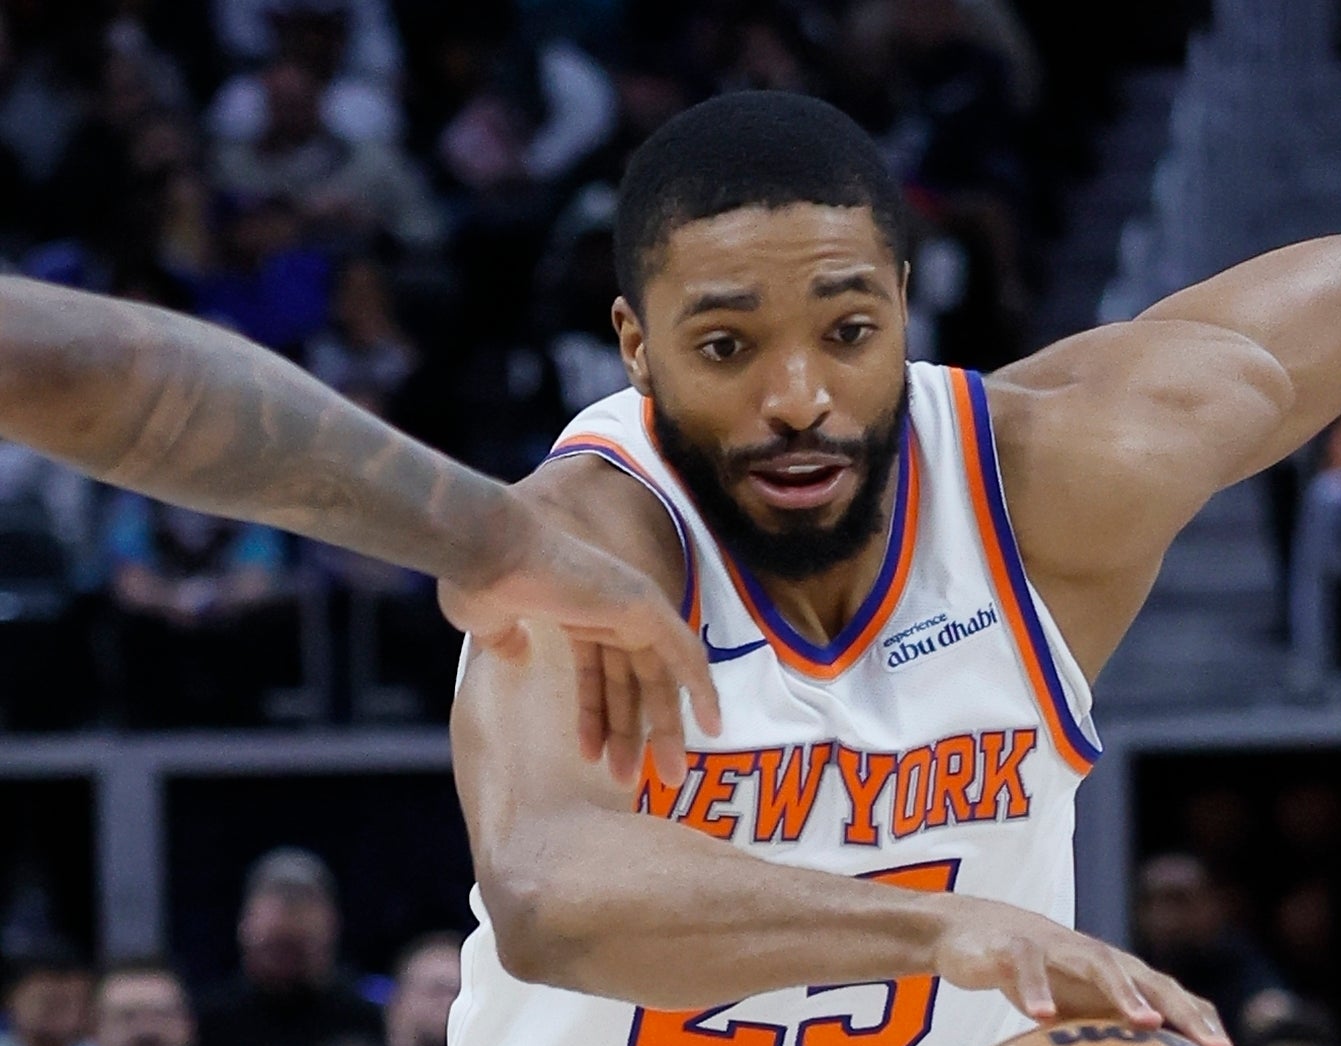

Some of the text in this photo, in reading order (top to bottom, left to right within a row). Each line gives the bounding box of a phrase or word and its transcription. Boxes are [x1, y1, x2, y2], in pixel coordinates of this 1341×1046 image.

[883, 613, 948, 648] experience
[887, 602, 998, 668] abu dhabi
[836, 727, 1039, 848] YORK
